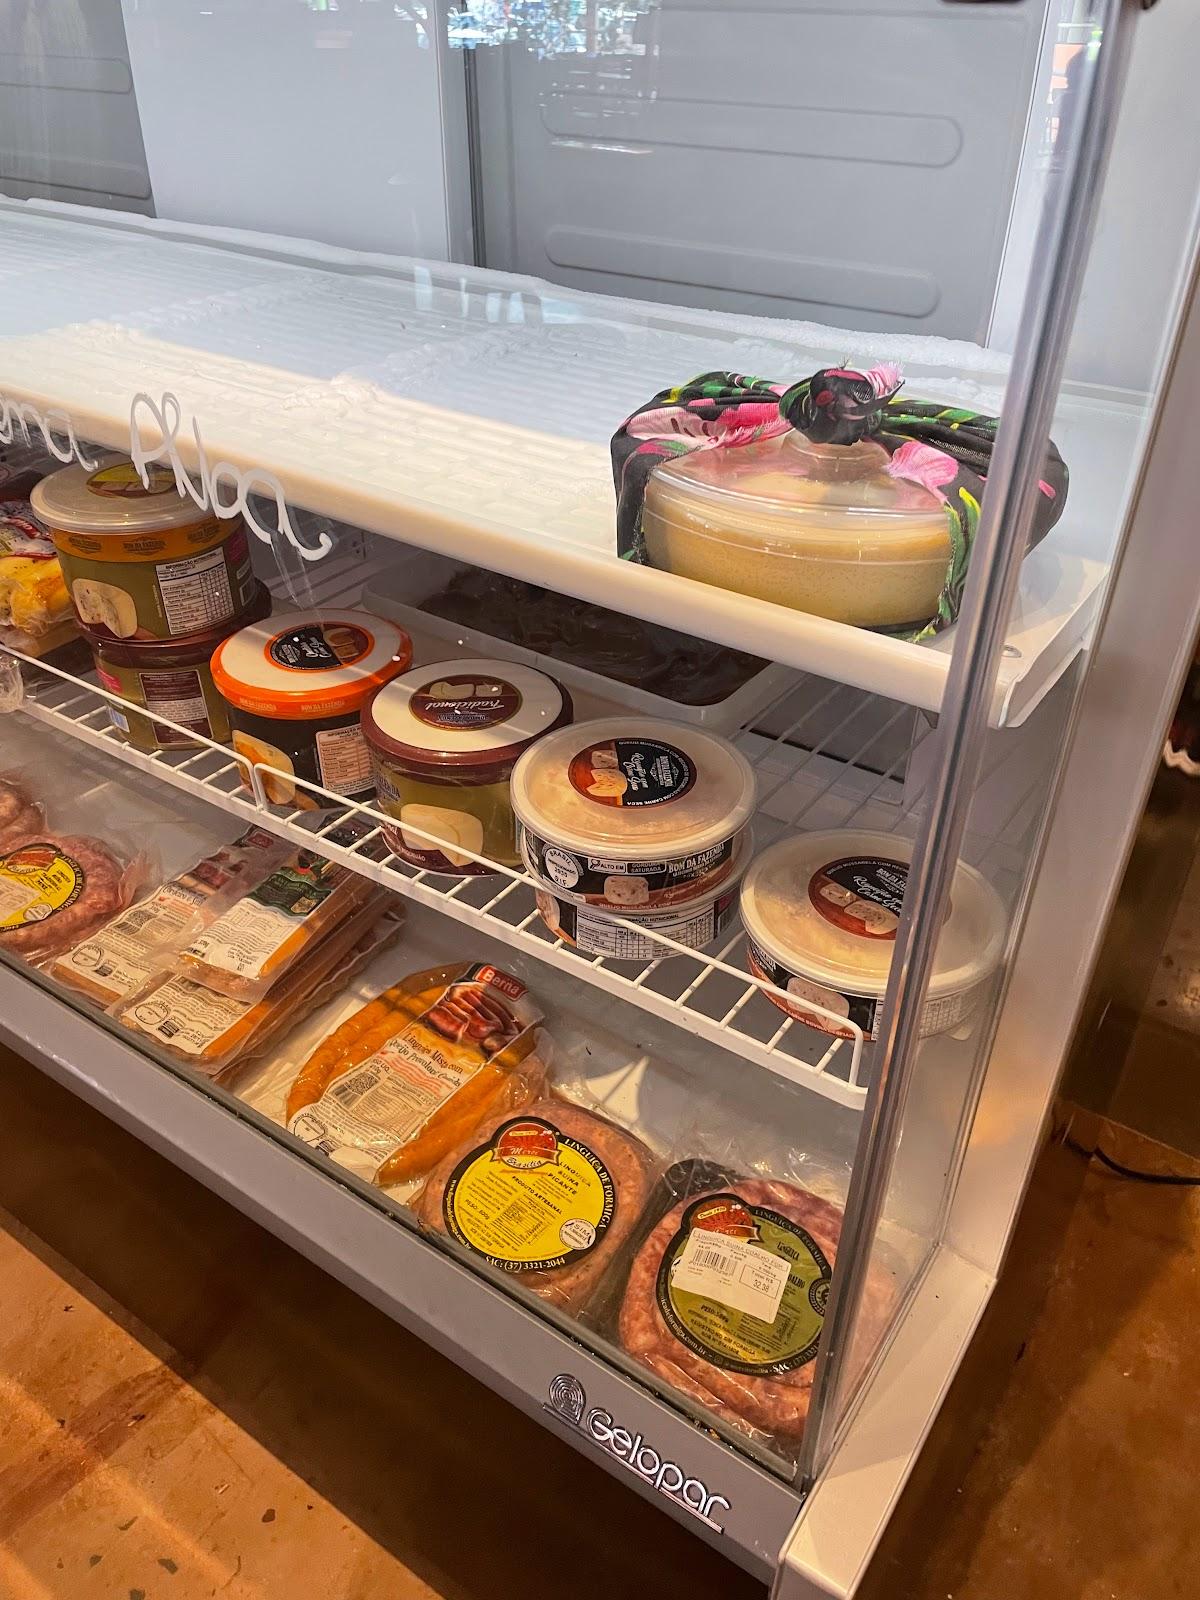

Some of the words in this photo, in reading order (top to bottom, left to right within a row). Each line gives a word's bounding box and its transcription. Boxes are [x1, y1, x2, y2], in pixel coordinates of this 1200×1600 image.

[130, 391, 334, 561] Alba
[668, 860, 686, 874] BOM
[686, 857, 697, 869] DA
[547, 1172, 577, 1196] PICANTE
[600, 1171, 611, 1185] DE
[512, 1175, 535, 1195] PRODUTO
[534, 1192, 563, 1215] ARTESANAL
[599, 1183, 614, 1229] FORMIGA
[504, 1260, 522, 1273] (37)
[523, 1256, 566, 1270] 3321-2044
[586, 1407, 731, 1517] Gelopar
